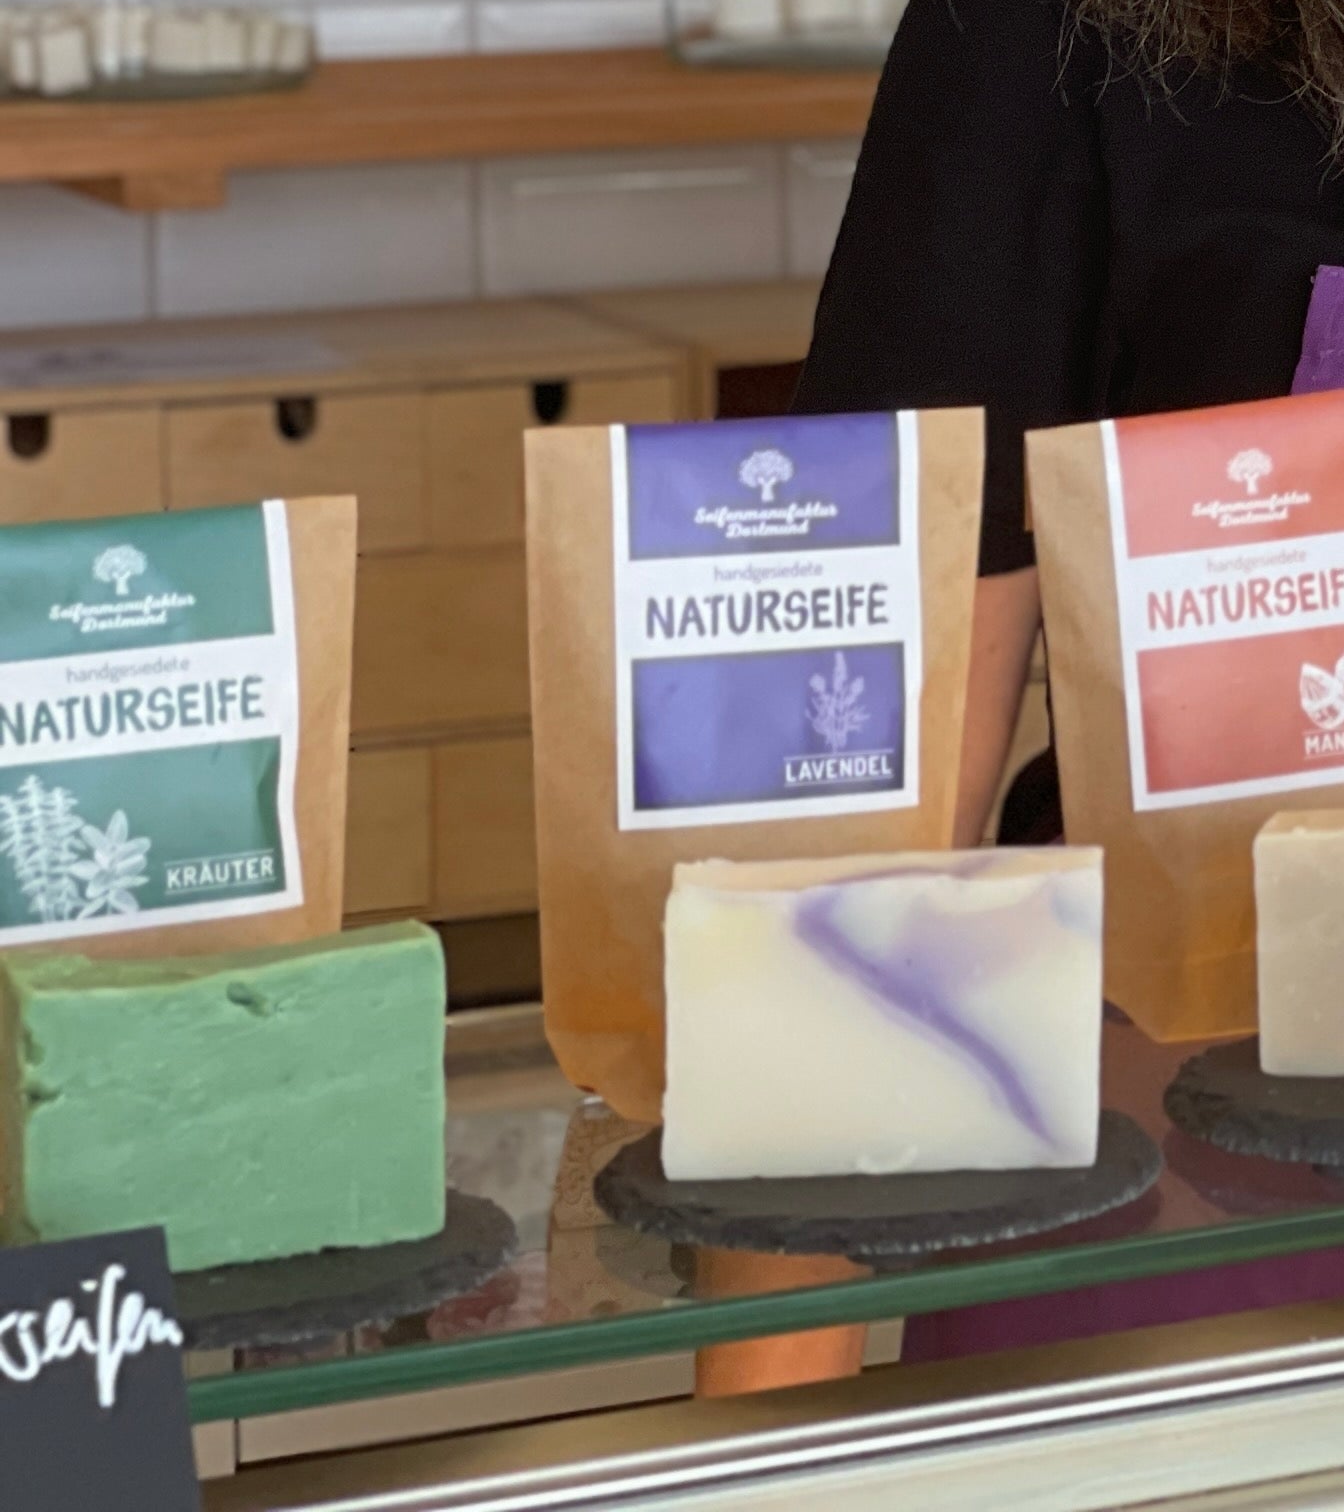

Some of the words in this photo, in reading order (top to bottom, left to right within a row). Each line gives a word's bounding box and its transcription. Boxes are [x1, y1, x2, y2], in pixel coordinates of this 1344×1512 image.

[694, 501, 838, 528] Seifenmanufaktur
[725, 520, 810, 538] Dortmund
[49, 592, 196, 624] Seifenmanufaktur
[81, 610, 168, 634] Dortmund
[646, 582, 890, 639] NATURSEIFE
[0, 675, 266, 746] NATURSEIFE
[785, 755, 892, 783] LAVENDEL
[166, 854, 274, 889] KRÄUTER
